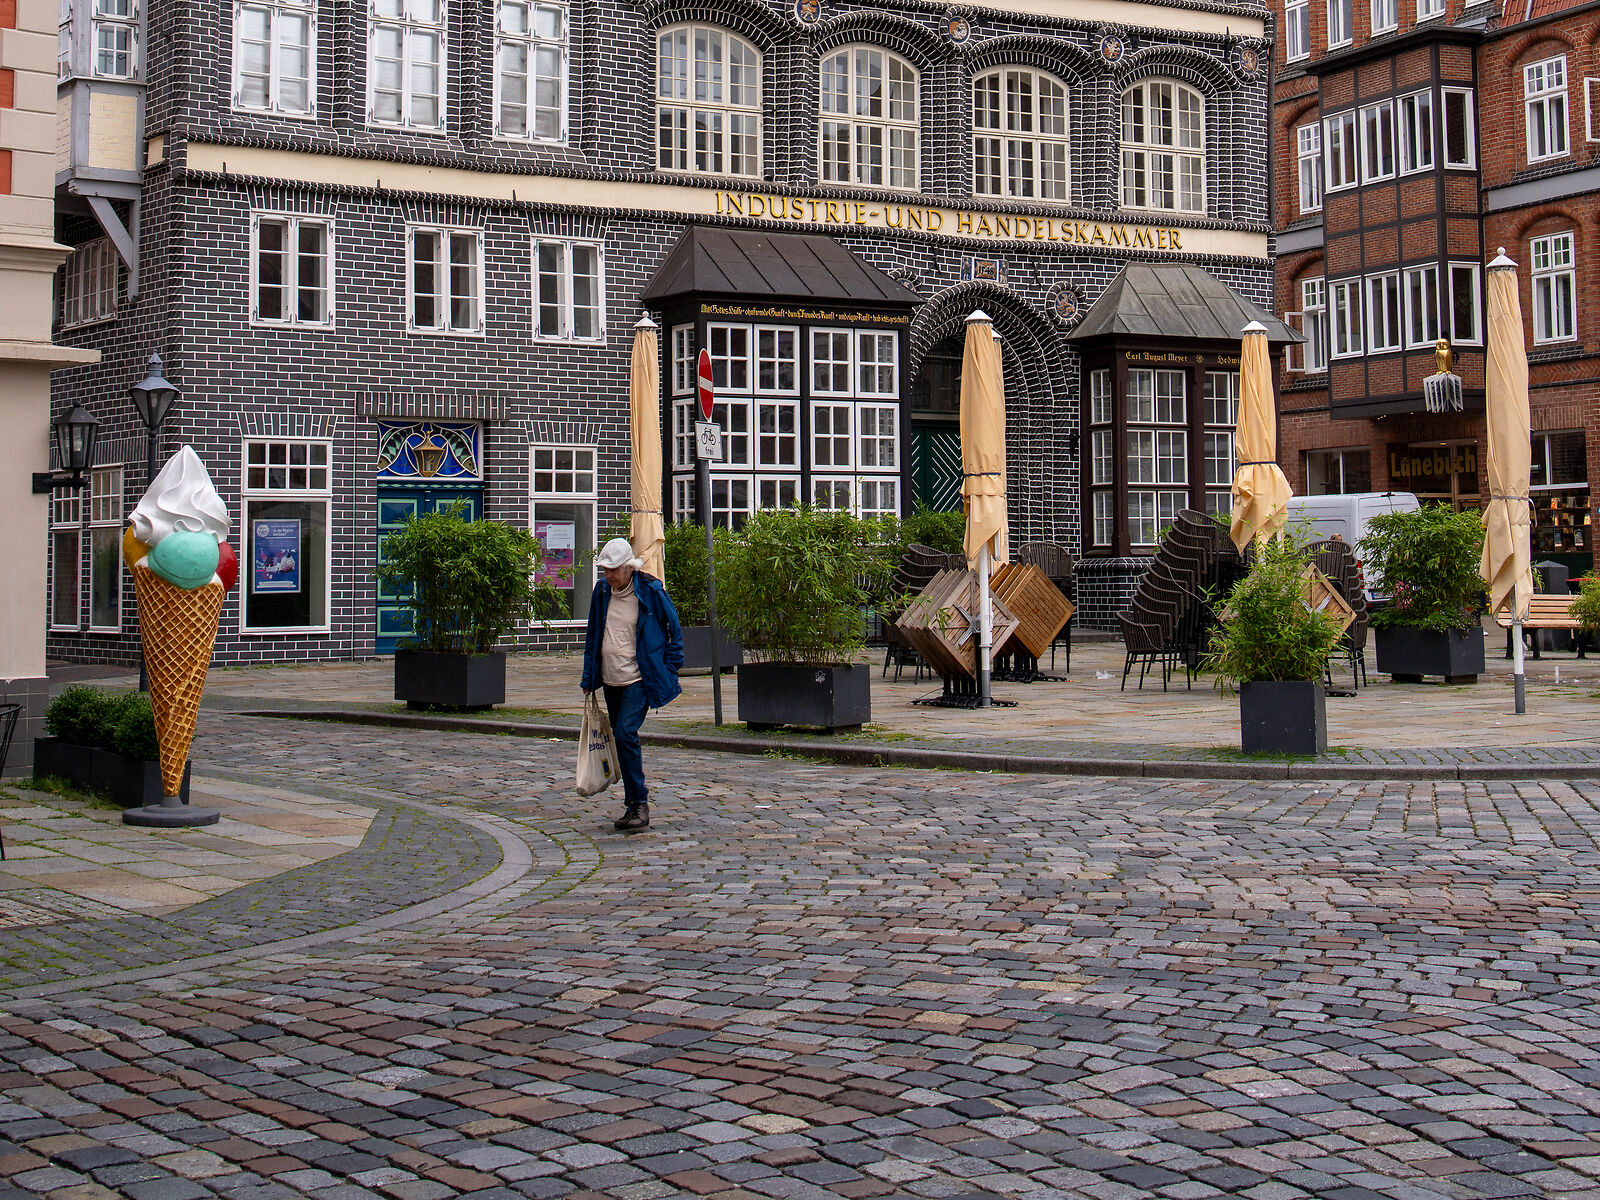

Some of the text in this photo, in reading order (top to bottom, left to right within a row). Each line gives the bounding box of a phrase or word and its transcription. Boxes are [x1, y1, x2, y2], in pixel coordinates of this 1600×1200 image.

[957, 211, 1183, 250] HANDELSKAMMER
[1125, 351, 1188, 363] Carl August Meyer
[1216, 355, 1241, 365] Hedwi
[705, 446, 714, 456] frei
[428, 453, 435, 465] 2
